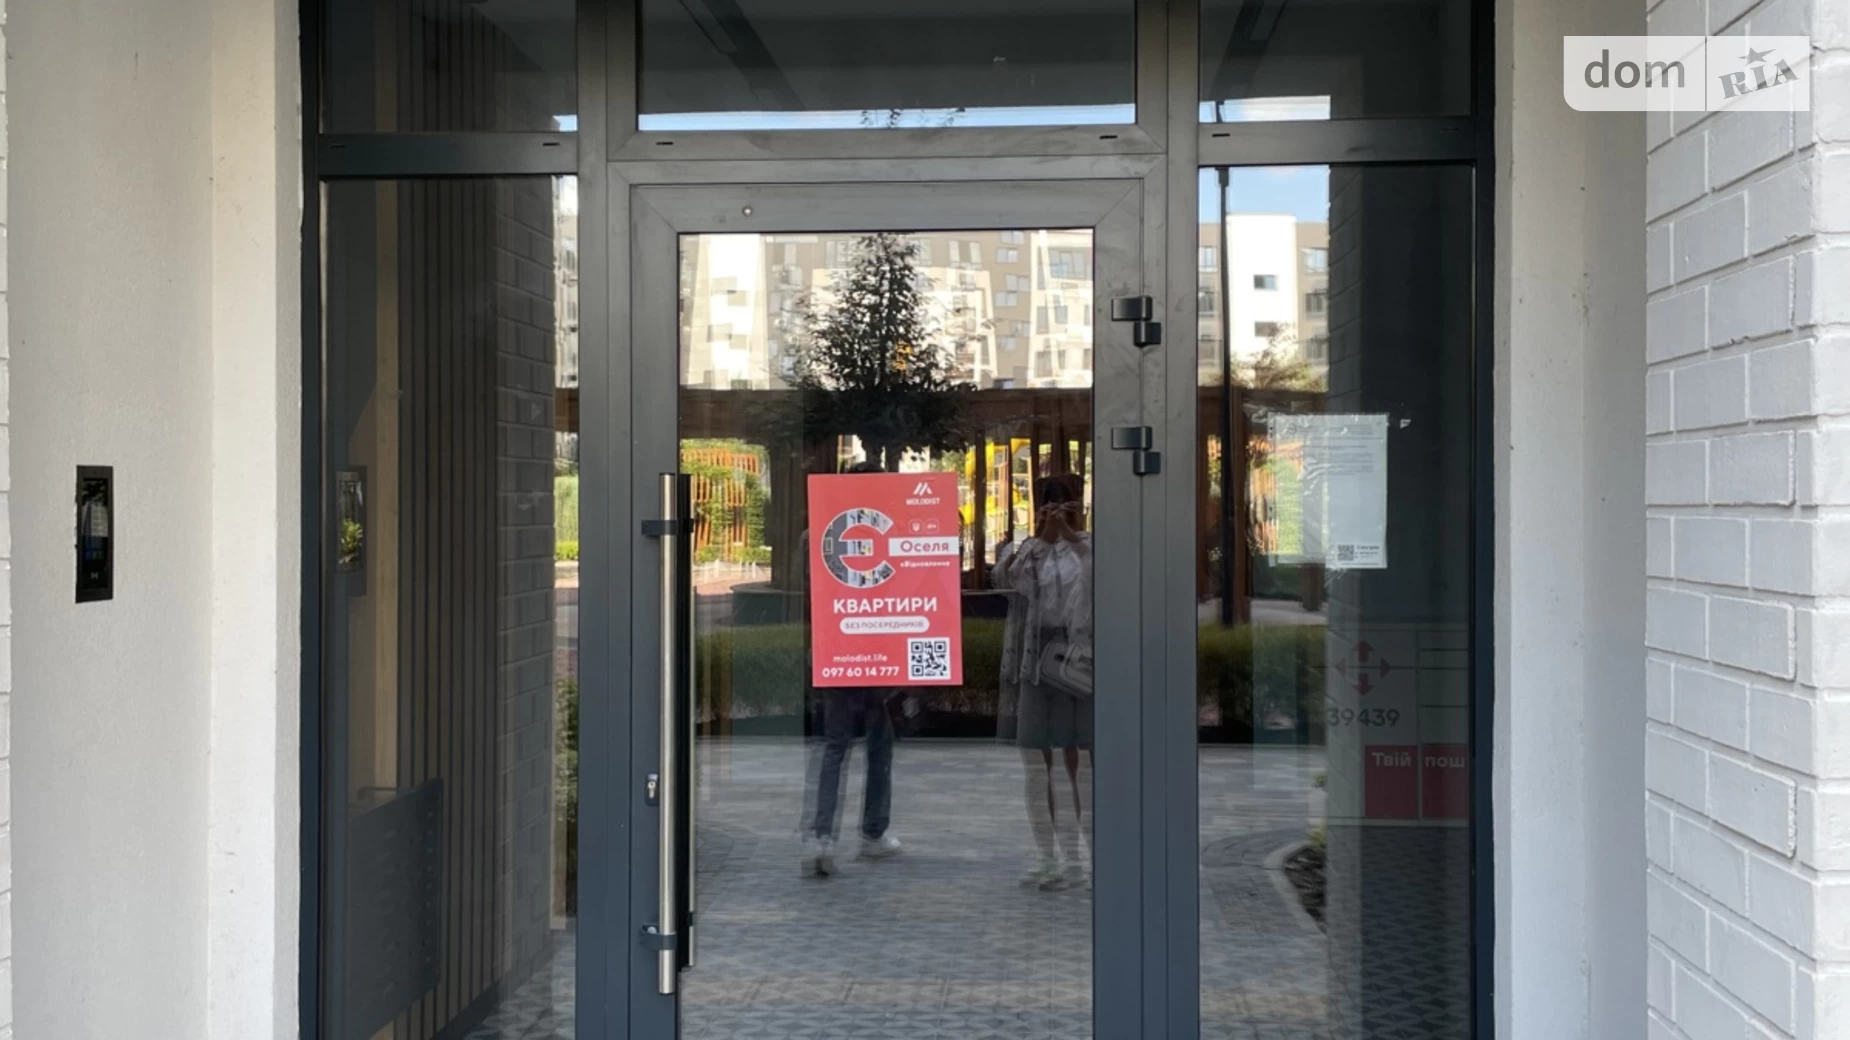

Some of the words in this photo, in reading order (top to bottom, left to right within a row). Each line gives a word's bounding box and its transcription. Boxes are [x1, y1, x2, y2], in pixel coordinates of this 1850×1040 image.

[900, 540, 949, 553] Оселя
[833, 597, 937, 614] КВАРТИРИ
[845, 621, 860, 629] БЕЗ
[861, 620, 924, 629] ПОСЕРЕДНИКІВ
[833, 653, 888, 663] molodist.life
[822, 667, 844, 678] 097
[846, 667, 863, 678] 60
[865, 667, 878, 677] 14
[879, 666, 900, 677] 777
[1371, 752, 1412, 767] Твій
[1425, 755, 1468, 768] пош
